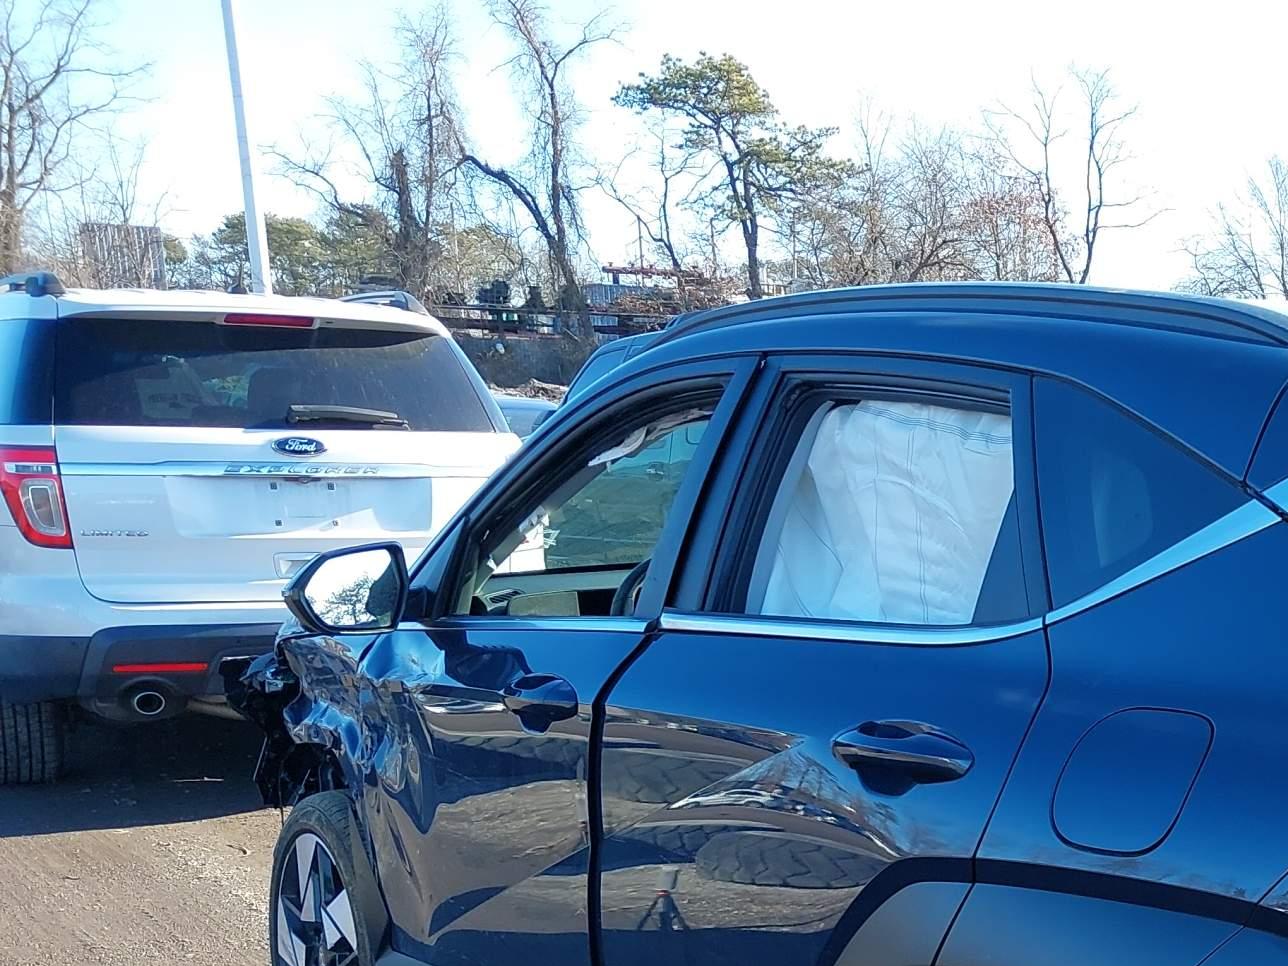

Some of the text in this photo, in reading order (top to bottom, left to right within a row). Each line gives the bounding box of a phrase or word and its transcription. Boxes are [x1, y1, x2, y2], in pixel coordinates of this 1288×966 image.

[285, 438, 317, 451] Ford
[223, 463, 380, 475] EXPLORER
[80, 529, 149, 537] LIMITED
